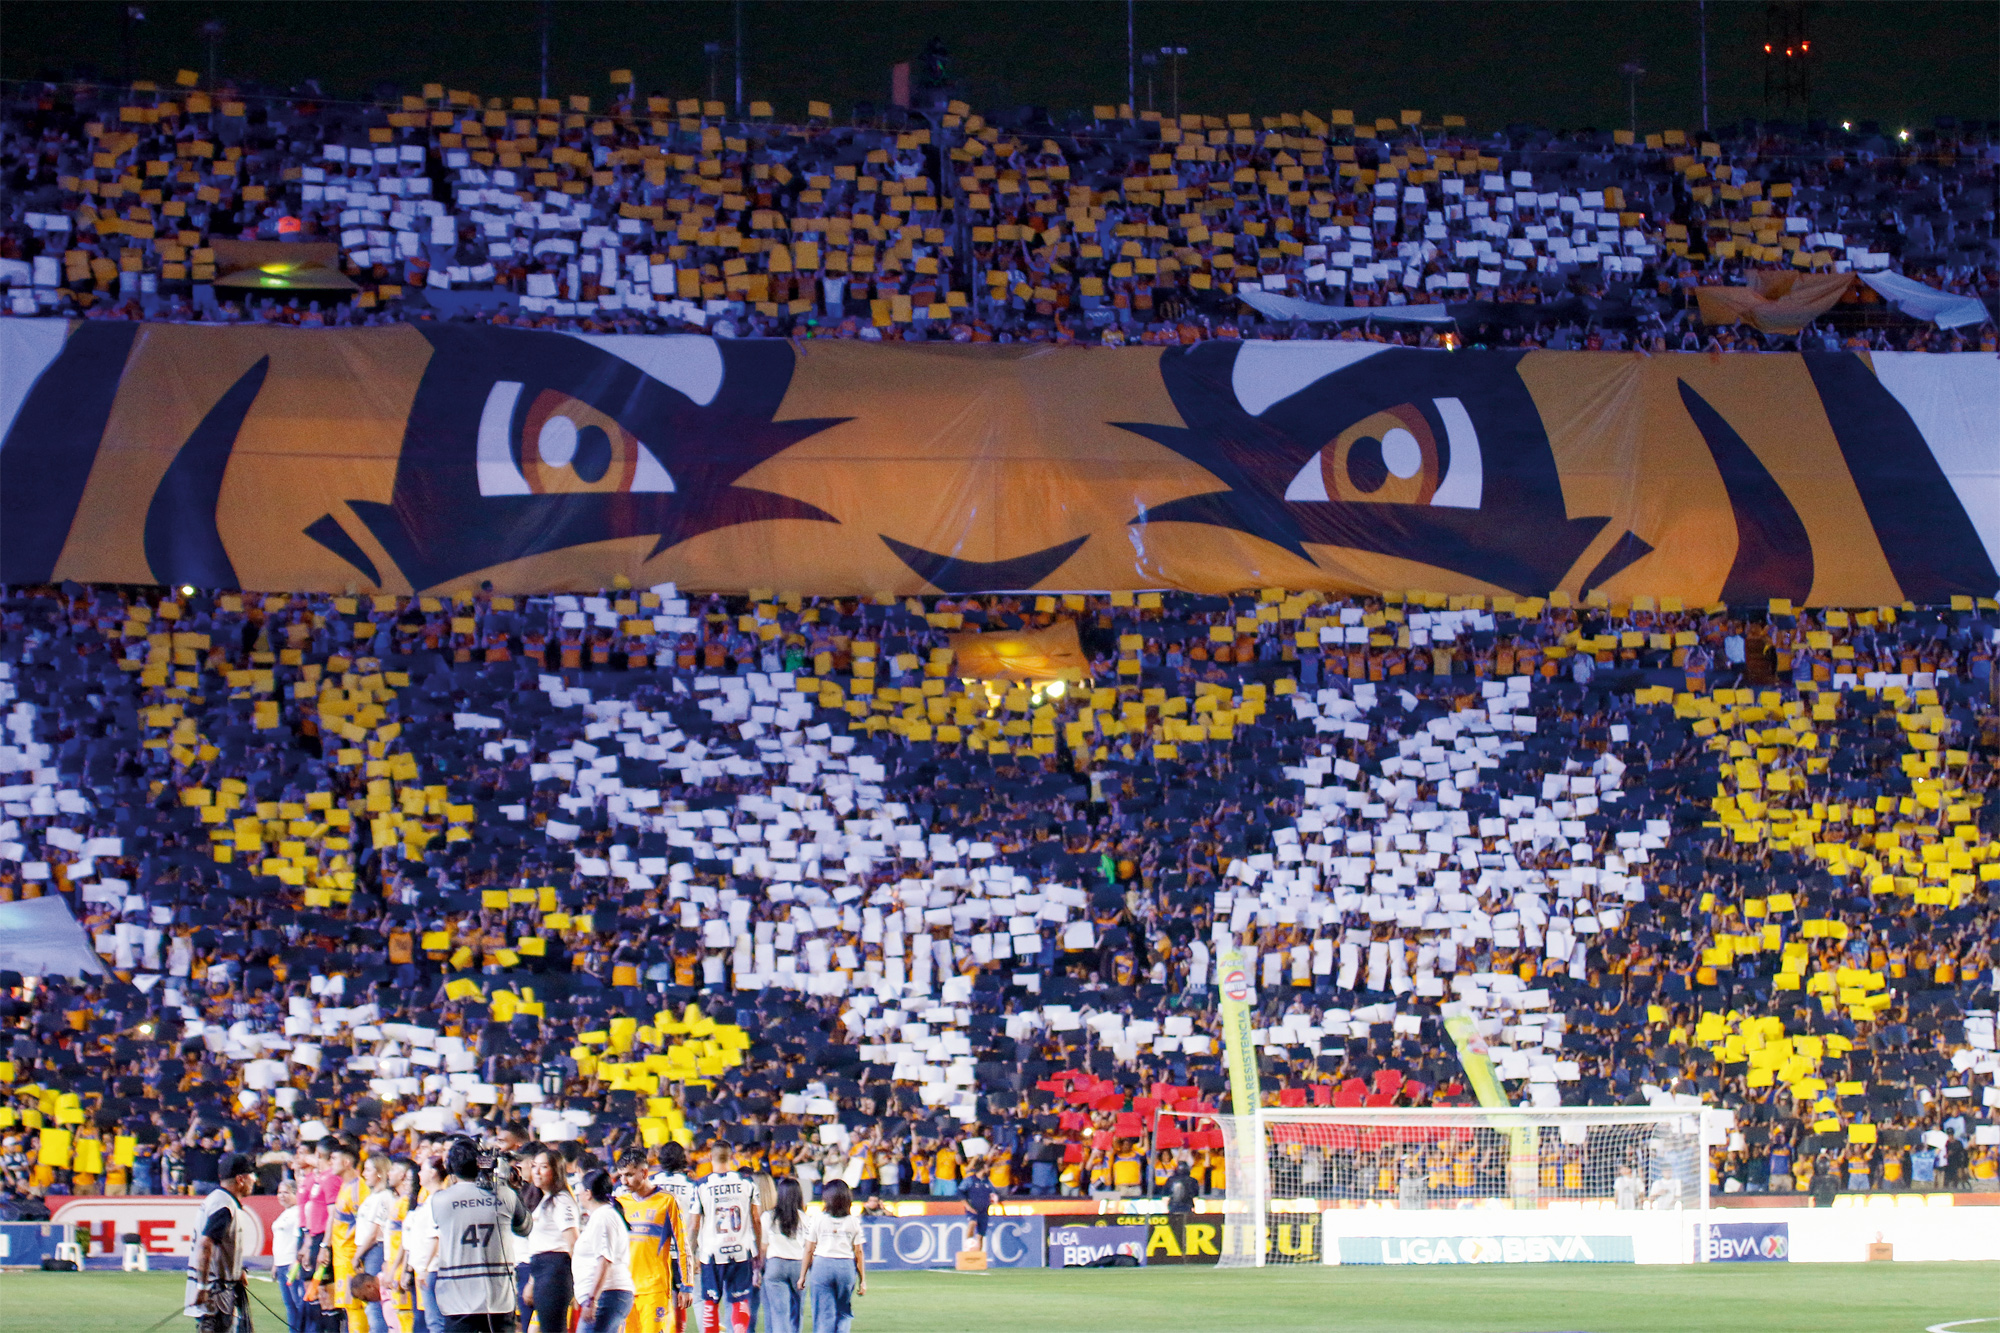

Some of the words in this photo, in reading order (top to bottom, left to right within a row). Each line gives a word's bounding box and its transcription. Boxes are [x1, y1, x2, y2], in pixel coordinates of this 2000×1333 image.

[1238, 1010, 1256, 1090] RESISTENCIA
[657, 1184, 687, 1195] CATE
[707, 1183, 742, 1196] TECATE
[452, 1197, 503, 1210] PRENSA
[715, 1205, 742, 1234] 20
[460, 1223, 495, 1248] 47
[1050, 1232, 1079, 1246] LIGA
[1063, 1244, 1114, 1266] BBVA
[1381, 1238, 1458, 1264] LIGA
[1502, 1235, 1595, 1263] BBVA
[1707, 1236, 1760, 1259] BBVA
